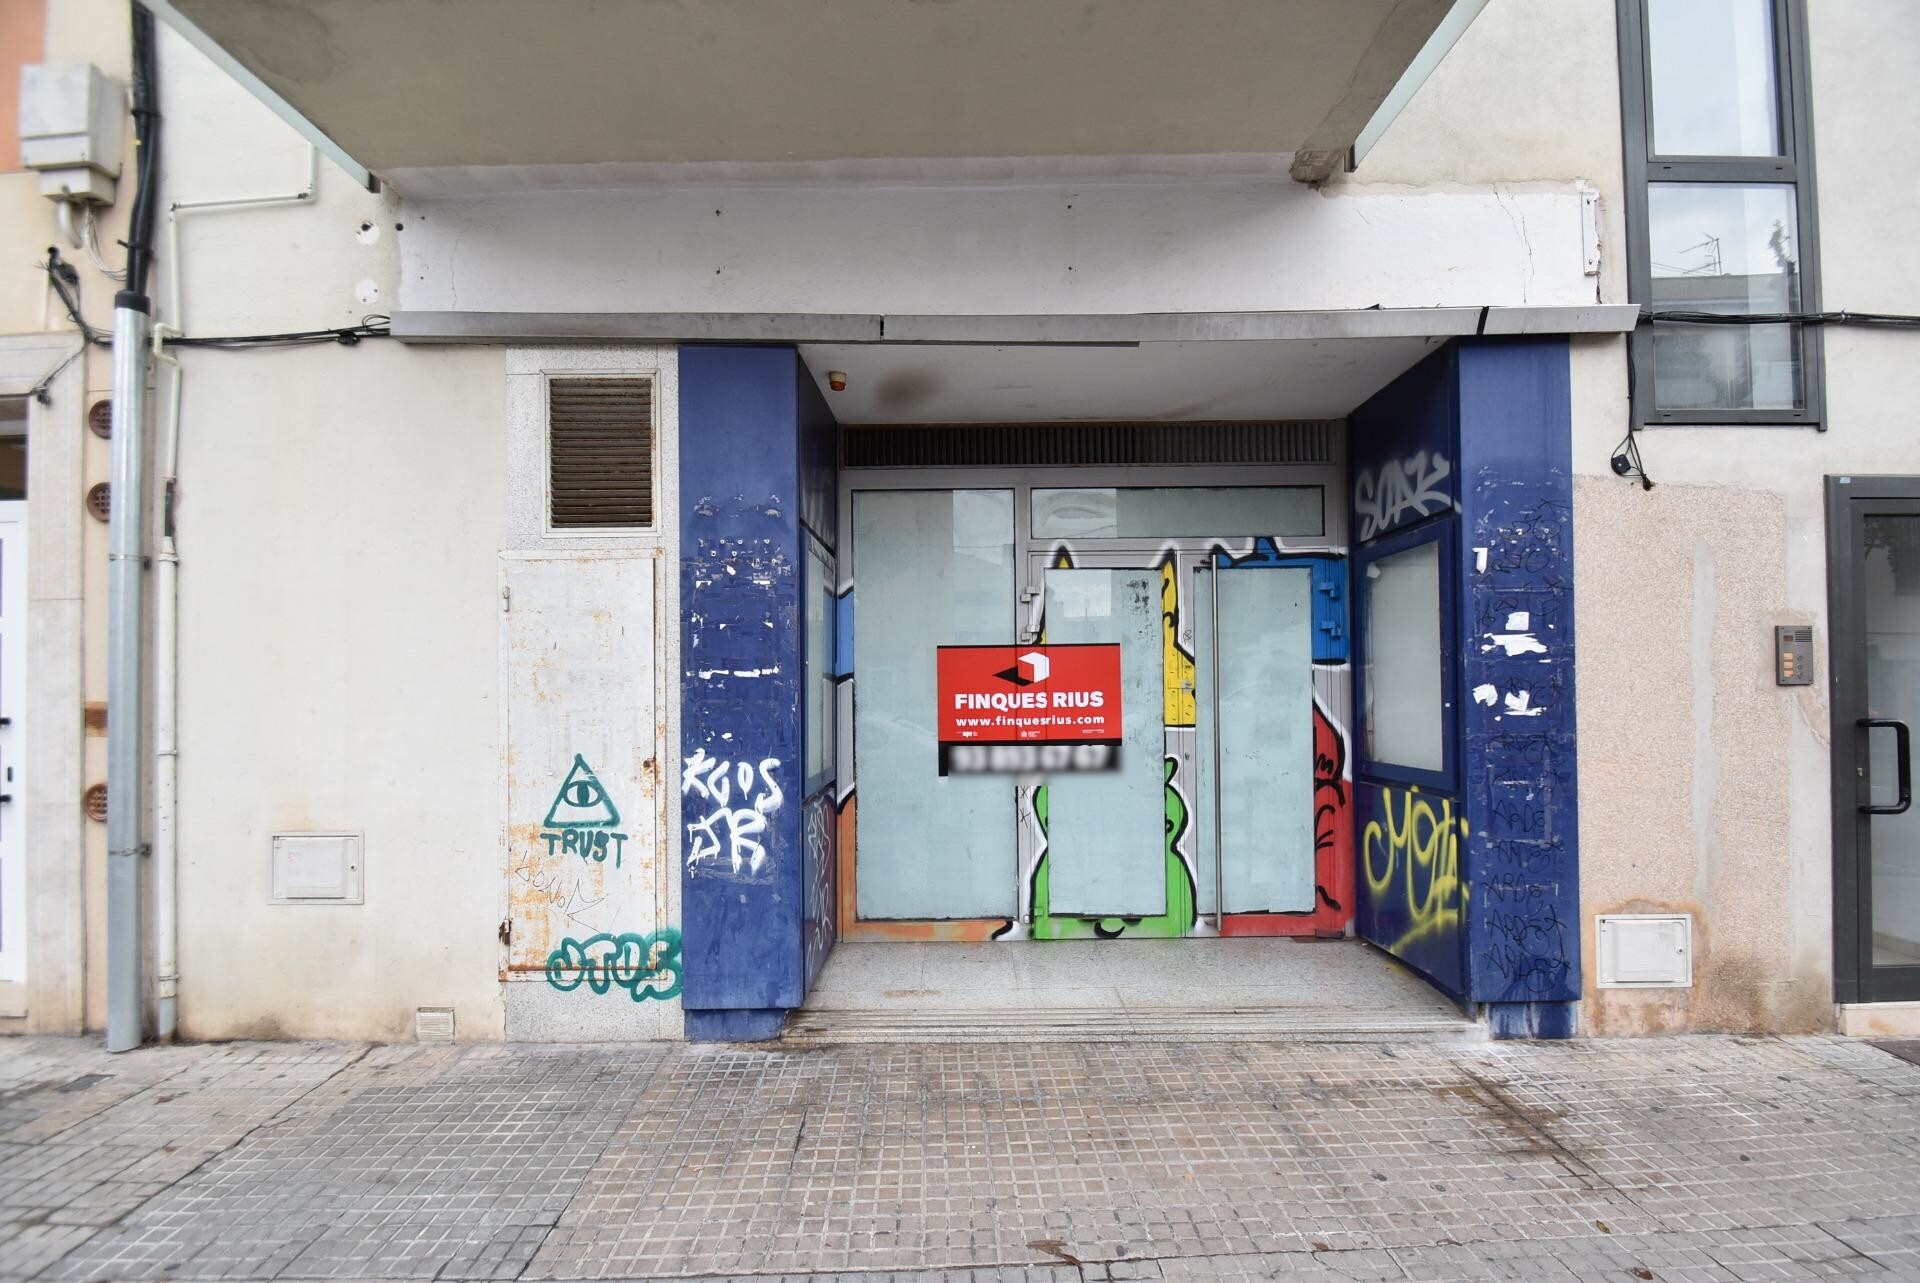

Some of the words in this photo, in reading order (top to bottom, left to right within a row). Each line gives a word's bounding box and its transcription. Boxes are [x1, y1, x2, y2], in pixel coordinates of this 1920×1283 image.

[954, 692, 1047, 713] FINQUES
[1053, 691, 1104, 708] RIUS
[956, 714, 1104, 728] www.finquesrius.com
[540, 829, 628, 869] TRUST
